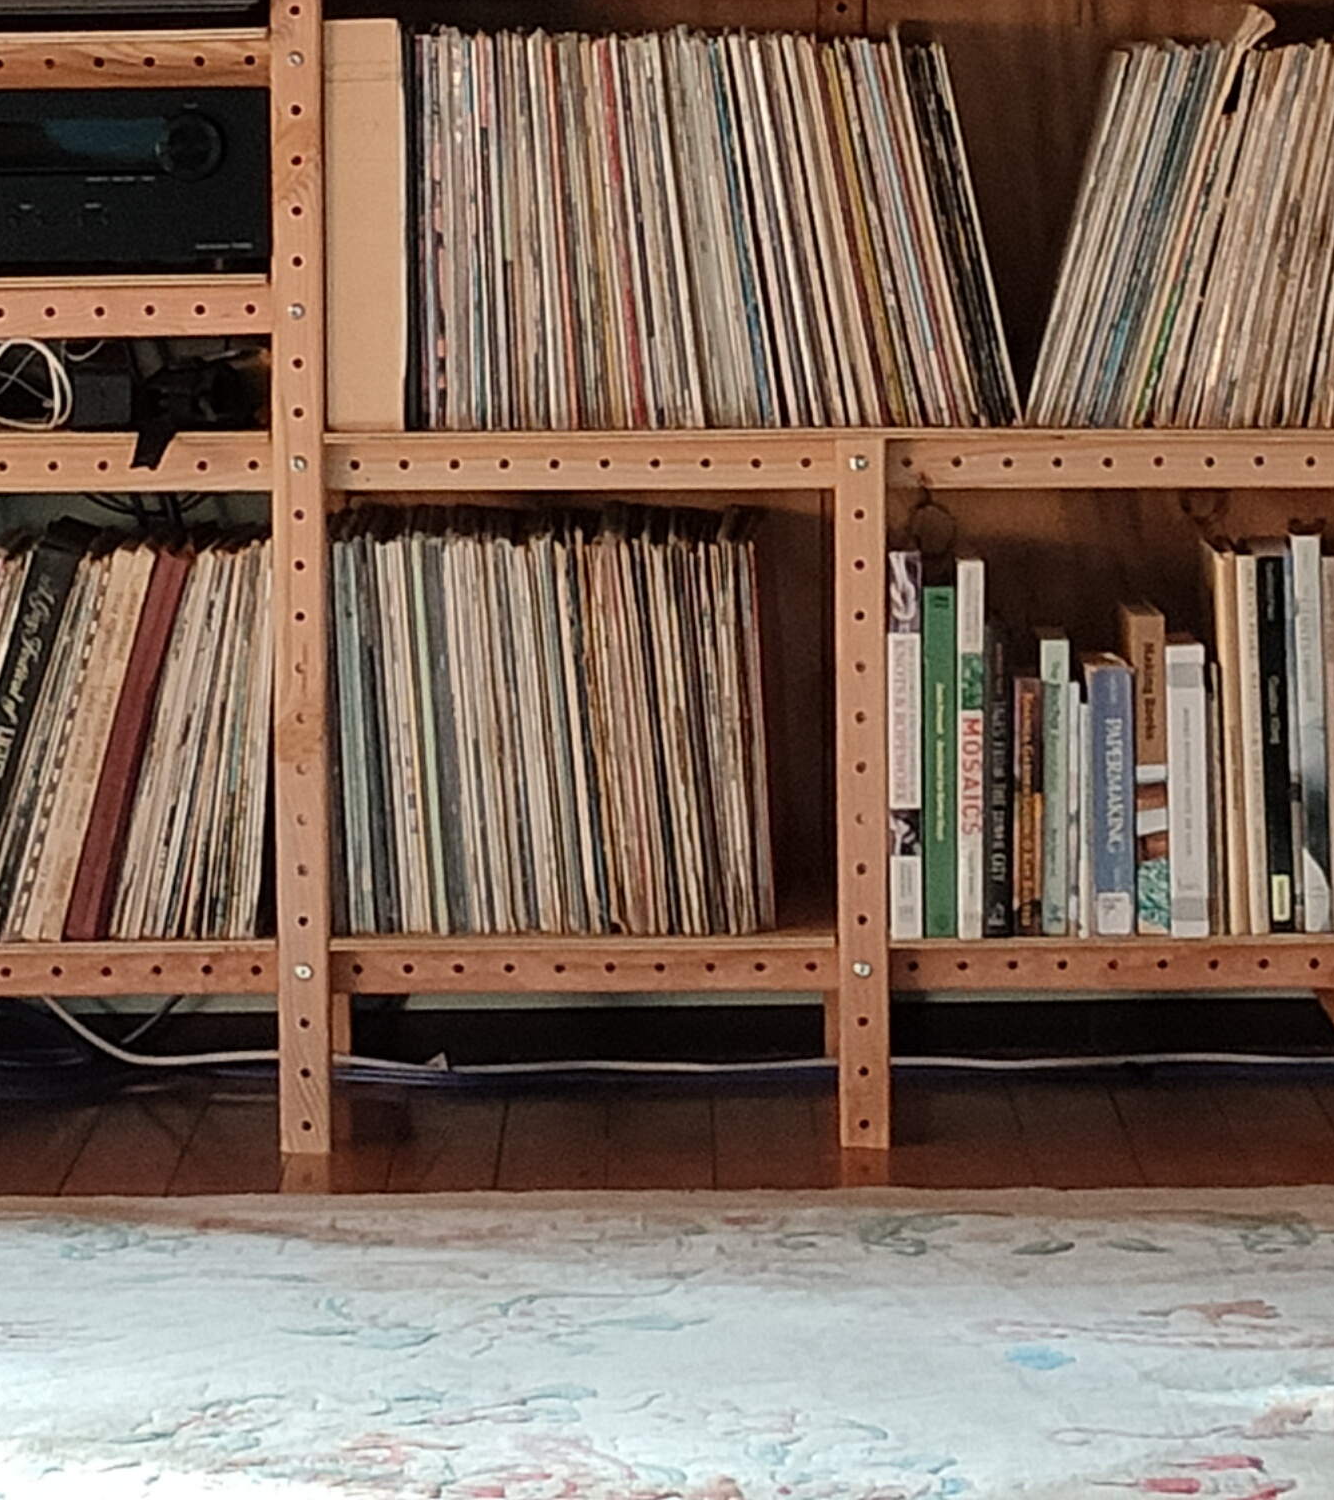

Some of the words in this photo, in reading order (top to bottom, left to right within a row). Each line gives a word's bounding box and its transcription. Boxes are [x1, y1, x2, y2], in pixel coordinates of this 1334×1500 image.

[893, 639, 907, 696] KNOTS
[1142, 642, 1156, 695] Making
[1144, 697, 1157, 741] Books
[893, 711, 907, 802] ROPEWORK
[962, 717, 982, 836] MOSAICS
[1105, 717, 1125, 854] PAPERMAKING
